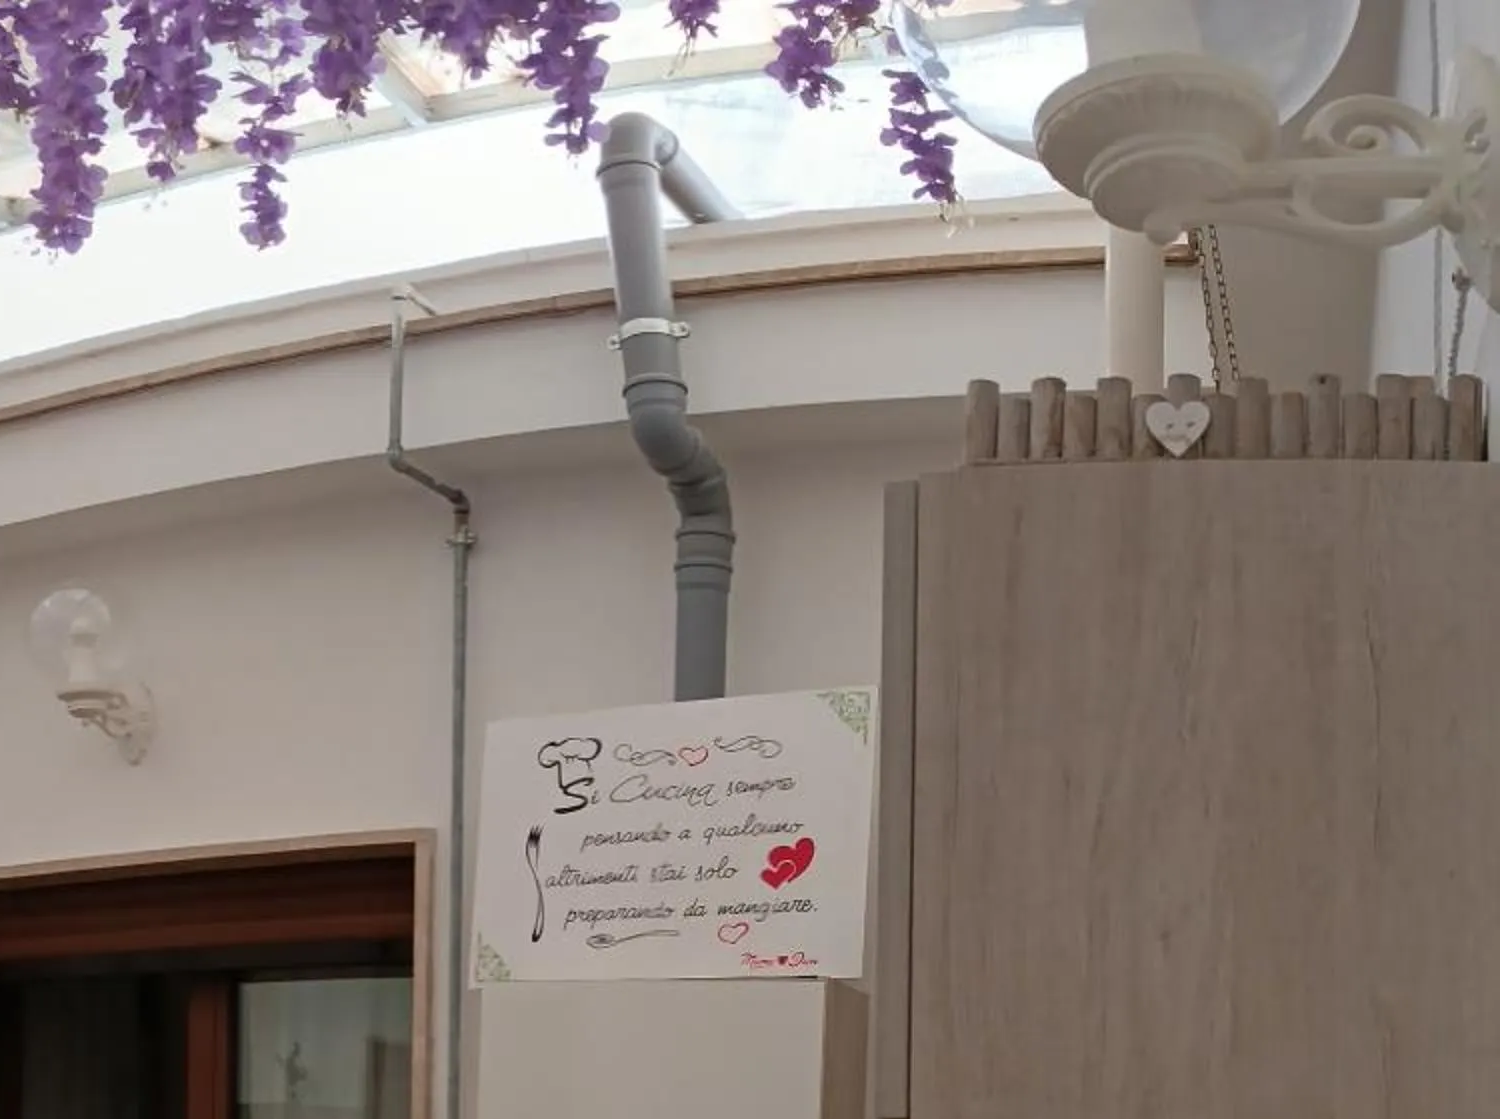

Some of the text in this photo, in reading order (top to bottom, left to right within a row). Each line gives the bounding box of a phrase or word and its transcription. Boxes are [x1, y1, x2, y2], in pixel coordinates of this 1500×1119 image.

[580, 822, 671, 852] pensando
[678, 829, 692, 841] a
[544, 855, 739, 889] altrimenti stai solo
[563, 901, 675, 931] preparando
[683, 897, 707, 919] da
